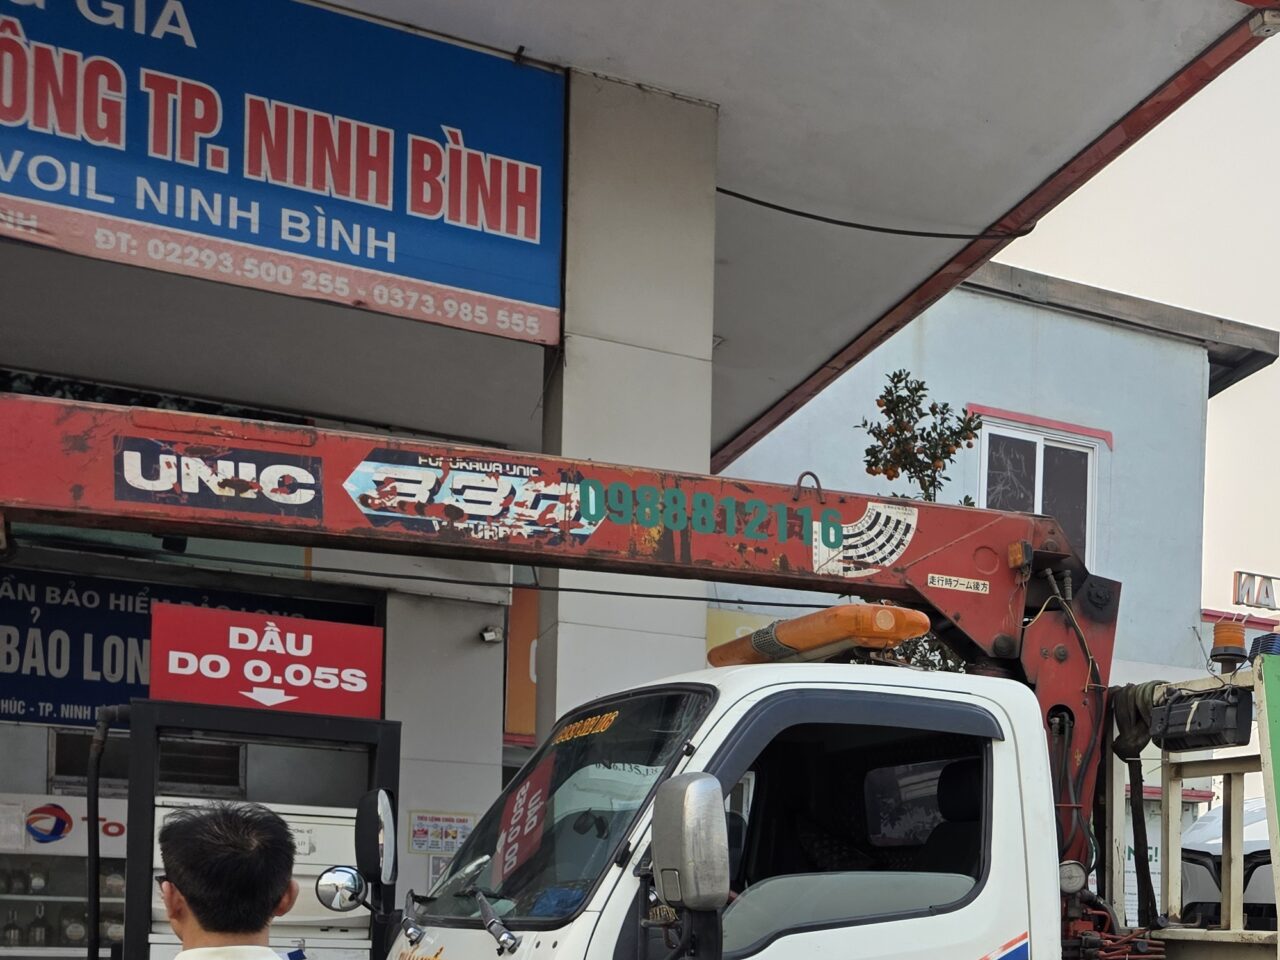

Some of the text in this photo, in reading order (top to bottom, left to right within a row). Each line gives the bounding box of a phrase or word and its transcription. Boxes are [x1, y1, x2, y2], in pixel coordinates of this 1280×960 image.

[139, 67, 229, 174] TP.
[243, 92, 394, 211] NINH
[405, 124, 542, 245] BÌNH
[136, 176, 259, 234] NINH
[281, 205, 396, 263] BÌNH
[94, 227, 137, 255] ĐT:
[147, 238, 293, 285] 02293.500
[301, 269, 350, 297] 255
[373, 284, 488, 326] 0373.985
[496, 310, 541, 336] 555
[122, 450, 316, 505] UNIC
[579, 478, 843, 549] 0988812116
[45, 580, 100, 608] BẢO
[0, 606, 150, 685] BẢO LON
[229, 621, 313, 657] DẦU
[168, 650, 368, 692] DO 0.05S
[38, 701, 57, 718] TP.
[60, 703, 91, 720] NINH
